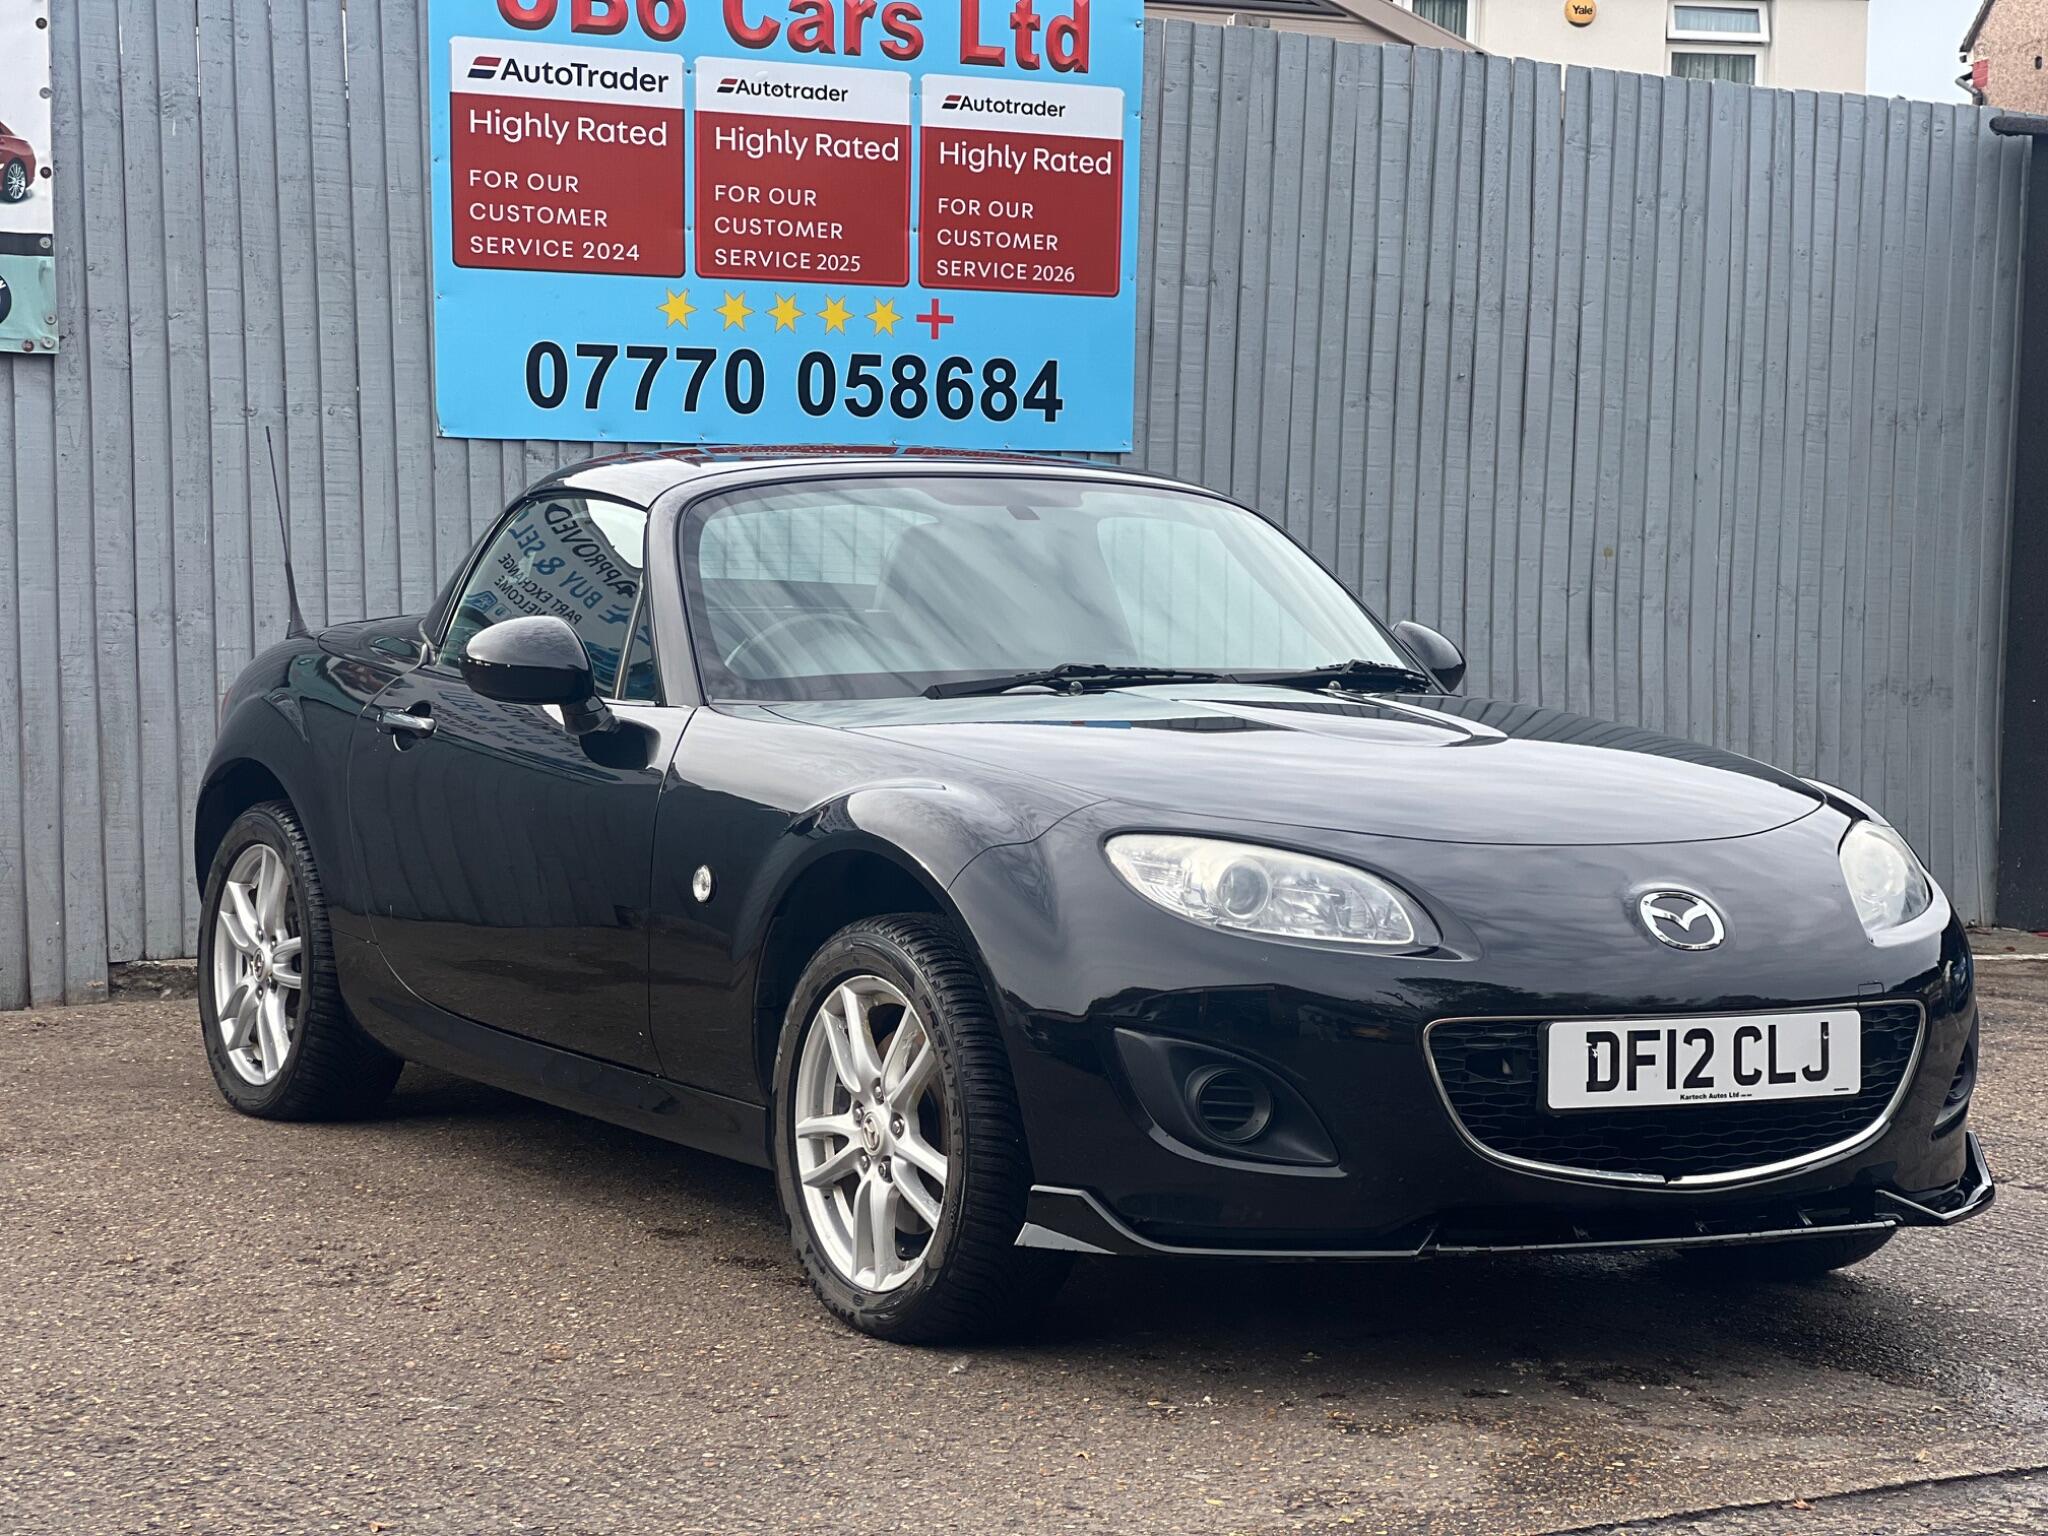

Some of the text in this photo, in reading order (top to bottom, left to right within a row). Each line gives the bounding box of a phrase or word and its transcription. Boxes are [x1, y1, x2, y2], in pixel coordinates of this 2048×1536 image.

[1572, 4, 1593, 15] Yale
[723, 0, 924, 62] Cars
[960, 0, 1090, 73] Ltd
[501, 58, 669, 93] AutoTrader
[735, 79, 849, 102] Autotrader
[959, 95, 1066, 118] Autotrader
[469, 109, 668, 147] Highly Rated
[715, 126, 899, 161] Highly Rated
[939, 142, 1112, 175] Highly Rated
[469, 169, 579, 193] FOR OUR
[715, 185, 817, 207] FOR OUR
[469, 203, 608, 228] CUSTOMER
[938, 198, 1034, 220] FOR OUR
[714, 216, 844, 240] CUSTOMER
[937, 229, 1058, 251] CUSTOMER
[470, 236, 641, 262] SERVICE 2024
[714, 248, 861, 272] SERVICE 2025
[936, 260, 1075, 283] SERVICE 2026
[525, 340, 1064, 423] 07770 058684
[1585, 1021, 1830, 1093] DF12 CLJ
